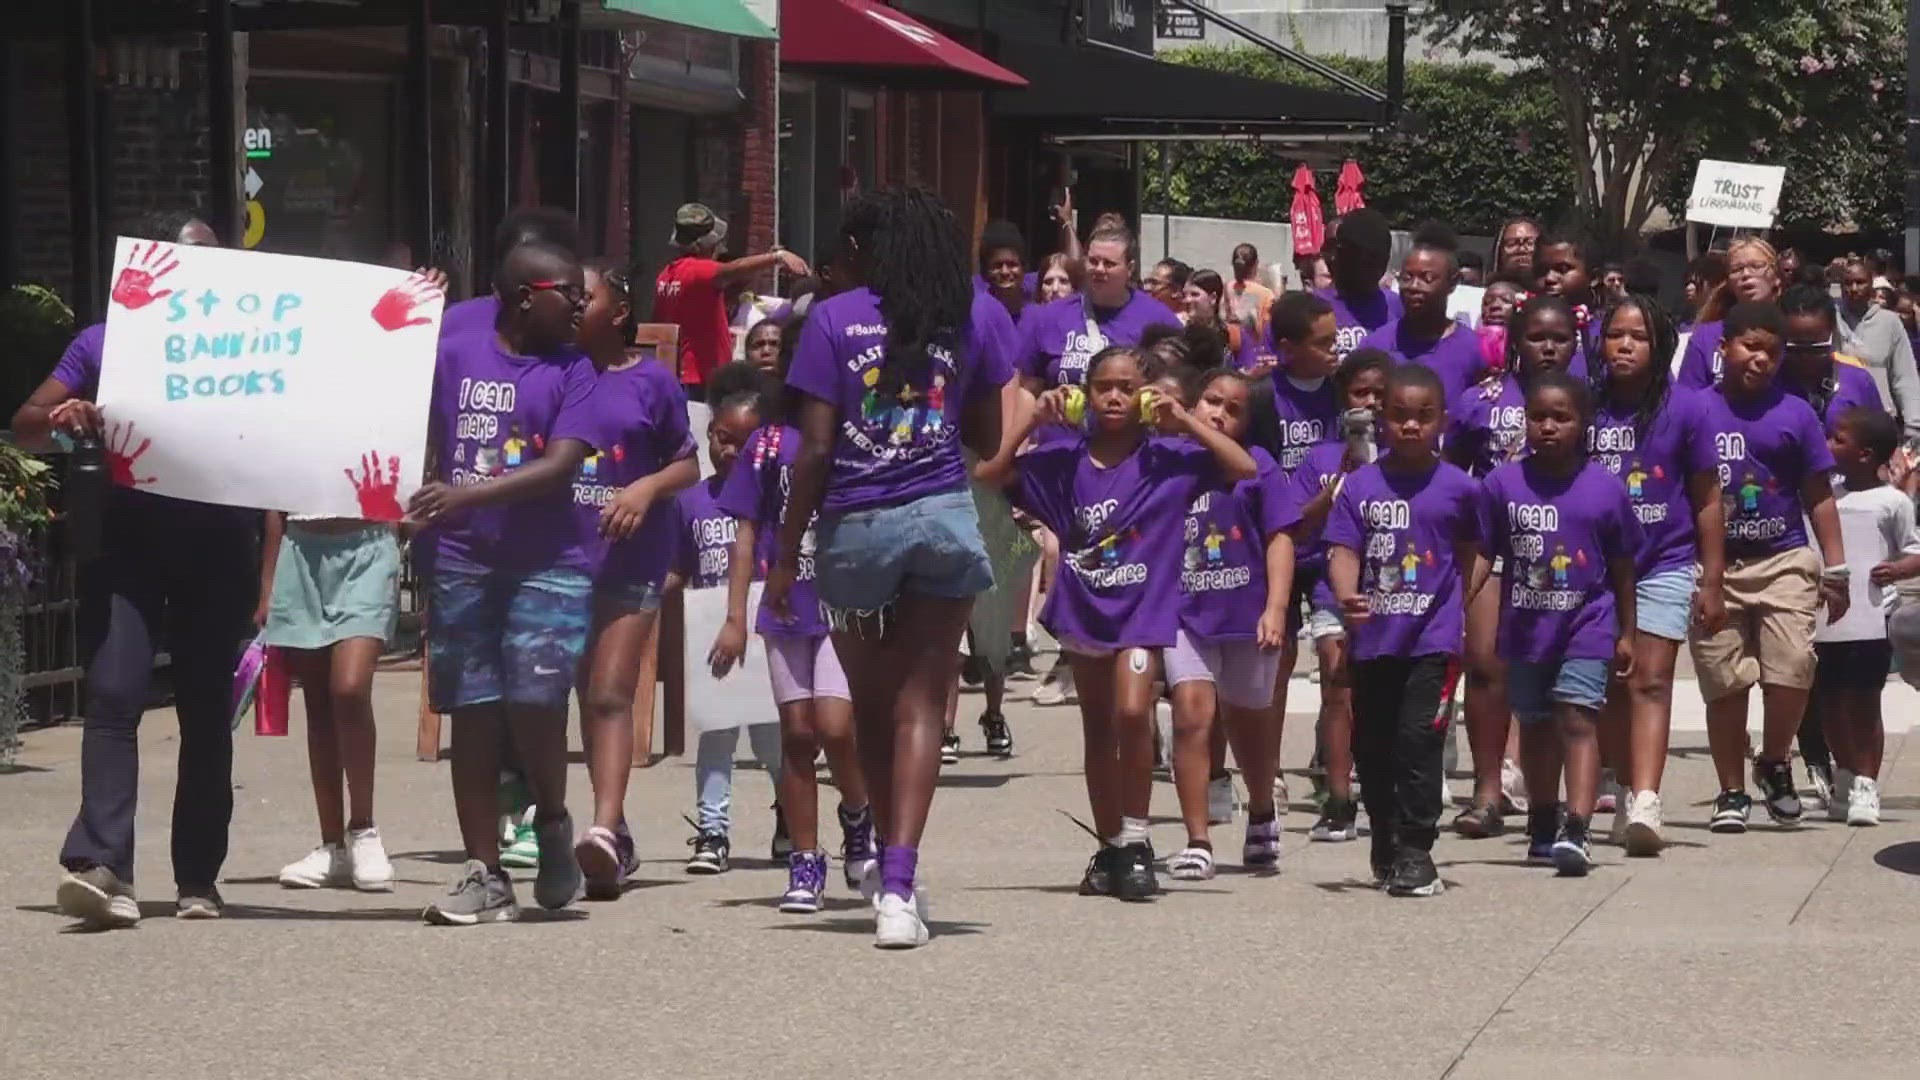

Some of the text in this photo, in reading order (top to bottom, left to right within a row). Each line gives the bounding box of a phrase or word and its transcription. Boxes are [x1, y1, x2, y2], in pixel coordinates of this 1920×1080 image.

[1174, 27, 1200, 36] WEEK
[1715, 180, 1764, 199] TRUST
[847, 345, 883, 373] EAST
[470, 381, 515, 412] can
[457, 414, 498, 444] make
[1597, 426, 1635, 451] can
[1370, 500, 1410, 529] can
[1518, 504, 1558, 532] can
